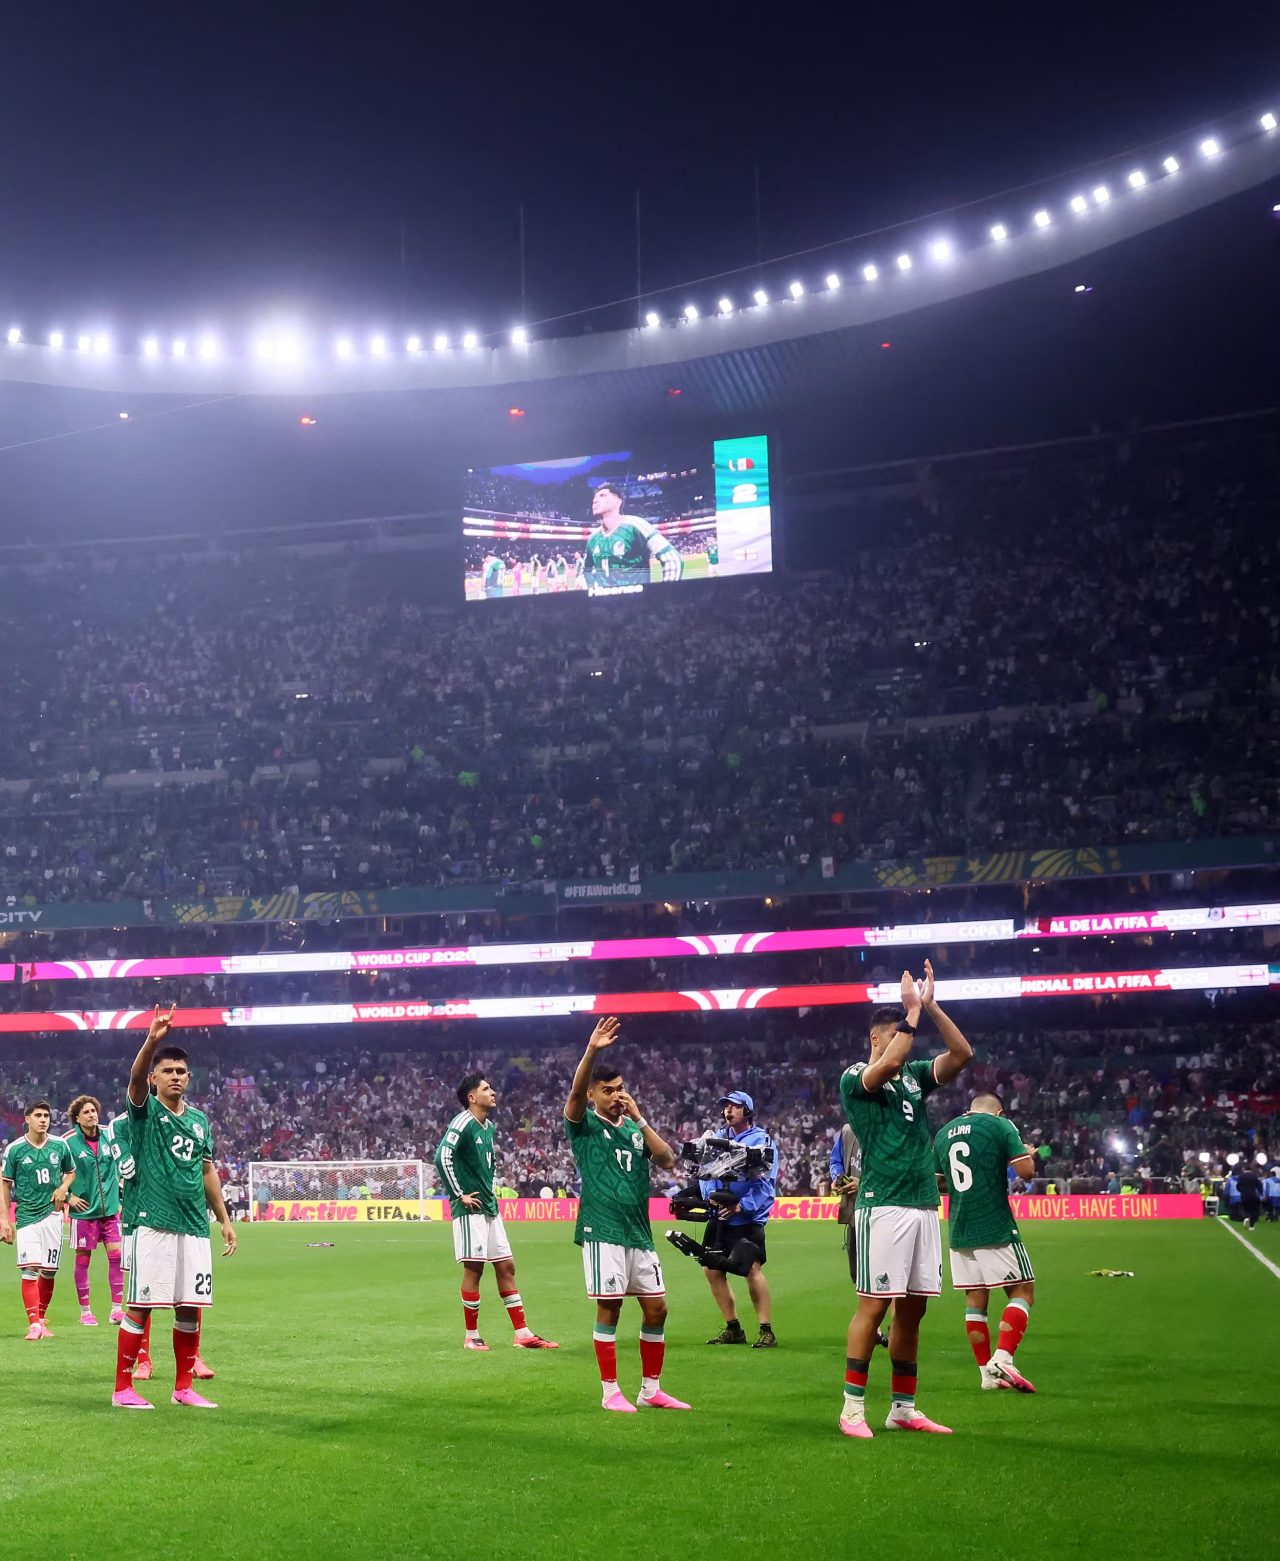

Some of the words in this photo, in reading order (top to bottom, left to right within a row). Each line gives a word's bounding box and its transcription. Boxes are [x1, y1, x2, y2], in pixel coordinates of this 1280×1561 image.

[732, 484, 757, 504] 2
[1069, 920, 1090, 933] DE
[1092, 918, 1112, 931] LA
[1114, 914, 1148, 930] FIFA
[357, 952, 402, 966] WORLD
[404, 949, 429, 964] CUP
[431, 947, 476, 962] 2026
[1005, 979, 1070, 997] MUNDIAL
[1073, 977, 1093, 991] DE
[1095, 976, 1117, 990] LA
[1118, 973, 1153, 989] FIFA
[359, 1003, 404, 1018] WORLD
[406, 1001, 431, 1016] CUP
[901, 1100, 913, 1122] 9
[171, 1134, 195, 1161] 23
[614, 1148, 632, 1172] 17
[948, 1142, 973, 1193] 6
[35, 1168, 50, 1185] 18
[288, 1203, 357, 1221] Active
[367, 1207, 402, 1221] FIFA
[525, 1202, 566, 1219] MOVE.
[1029, 1200, 1074, 1218] MOVE.
[1080, 1200, 1116, 1218] HAVE
[1122, 1199, 1157, 1218] FUN!
[47, 1248, 58, 1264] 18
[195, 1272, 212, 1295] 23
